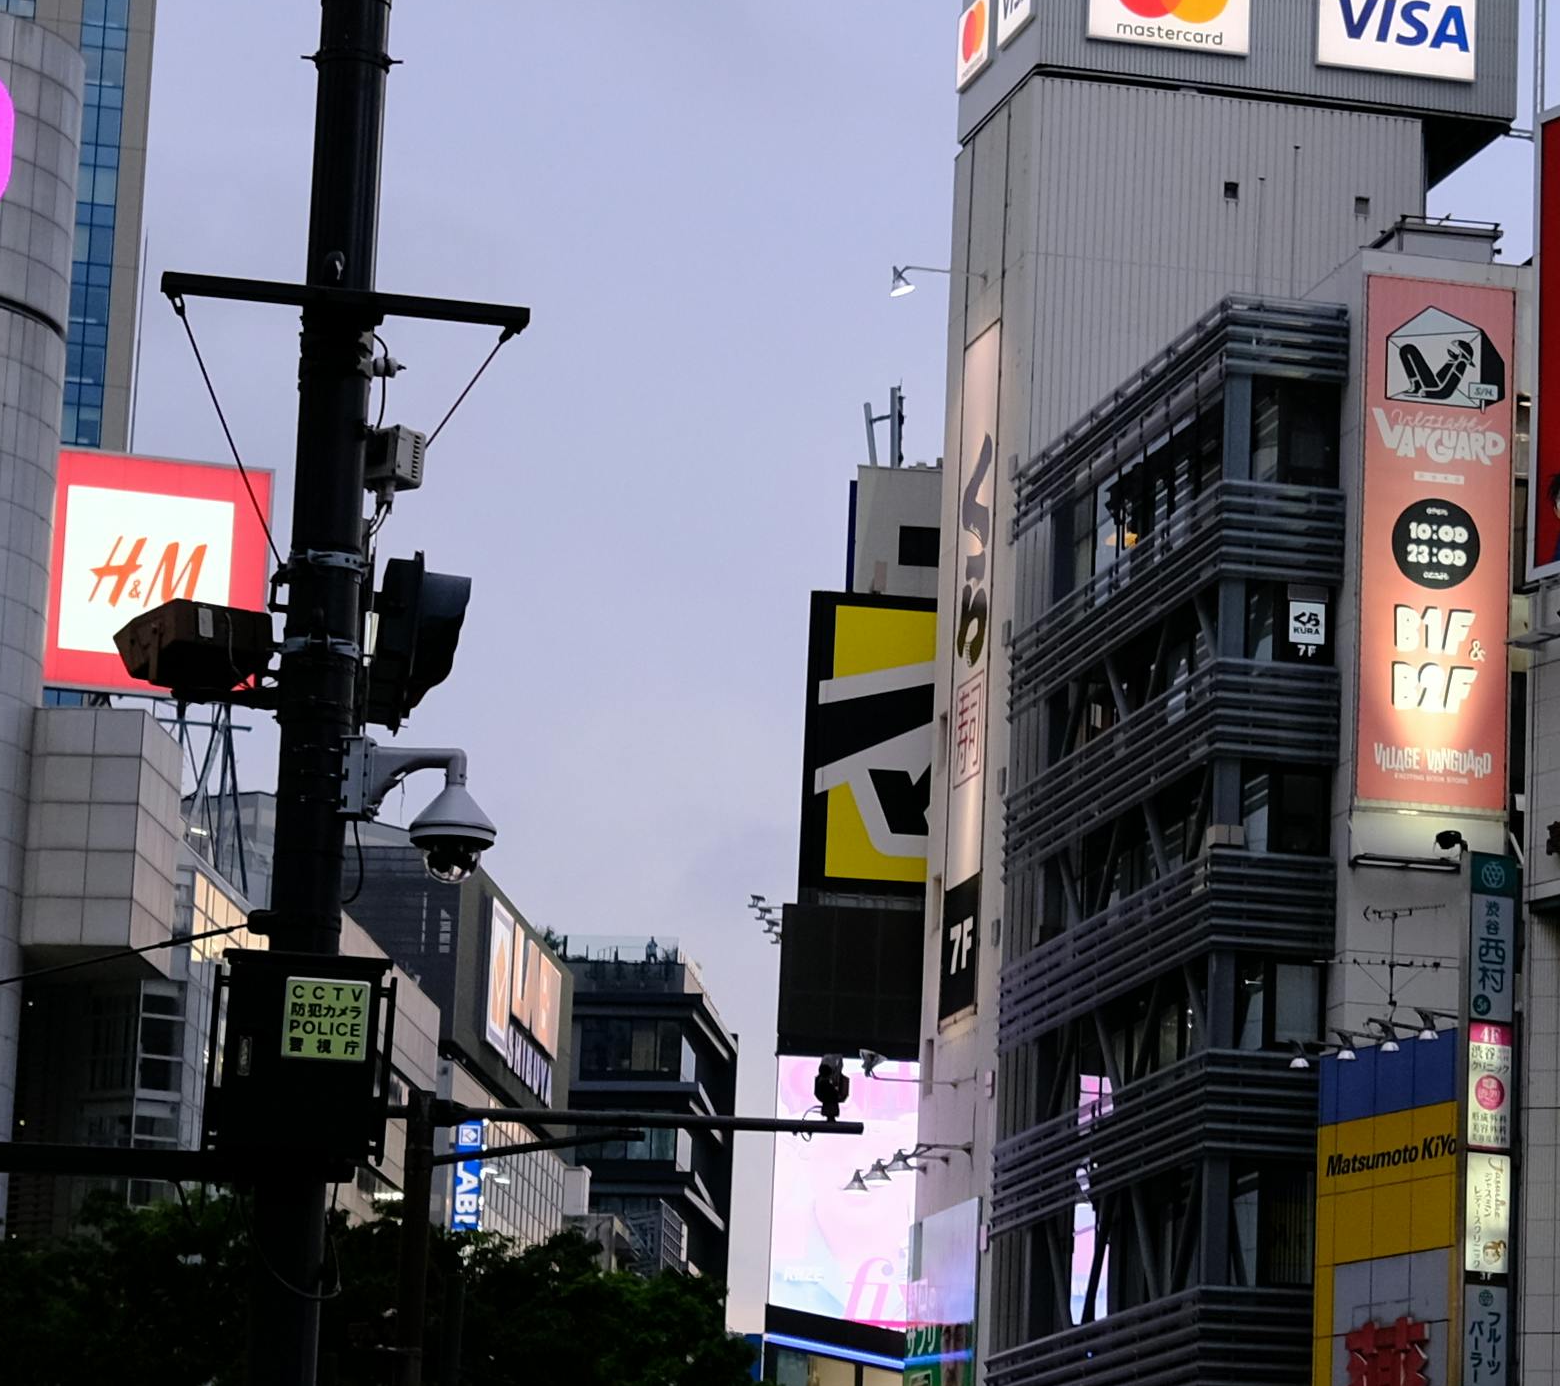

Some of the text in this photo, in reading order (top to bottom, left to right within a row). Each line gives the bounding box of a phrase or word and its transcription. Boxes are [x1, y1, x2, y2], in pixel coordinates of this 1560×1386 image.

[1116, 20, 1224, 46] mastercard
[1408, 521, 1469, 544] 10:00
[1407, 543, 1467, 566] 23:00
[88, 534, 208, 605] H&M
[1394, 604, 1476, 656] B1F
[1296, 644, 1318, 658] 7F
[949, 915, 974, 976] 7F
[1478, 900, 1506, 993] 渋谷西村
[291, 1002, 362, 1019] 防犯カメラ
[289, 1020, 360, 1037] POLICE
[1480, 1025, 1499, 1042] 4F
[289, 1037, 360, 1055] 警視庁
[1326, 1144, 1419, 1177] Matsumoto
[1487, 1312, 1501, 1375] フルーツ
